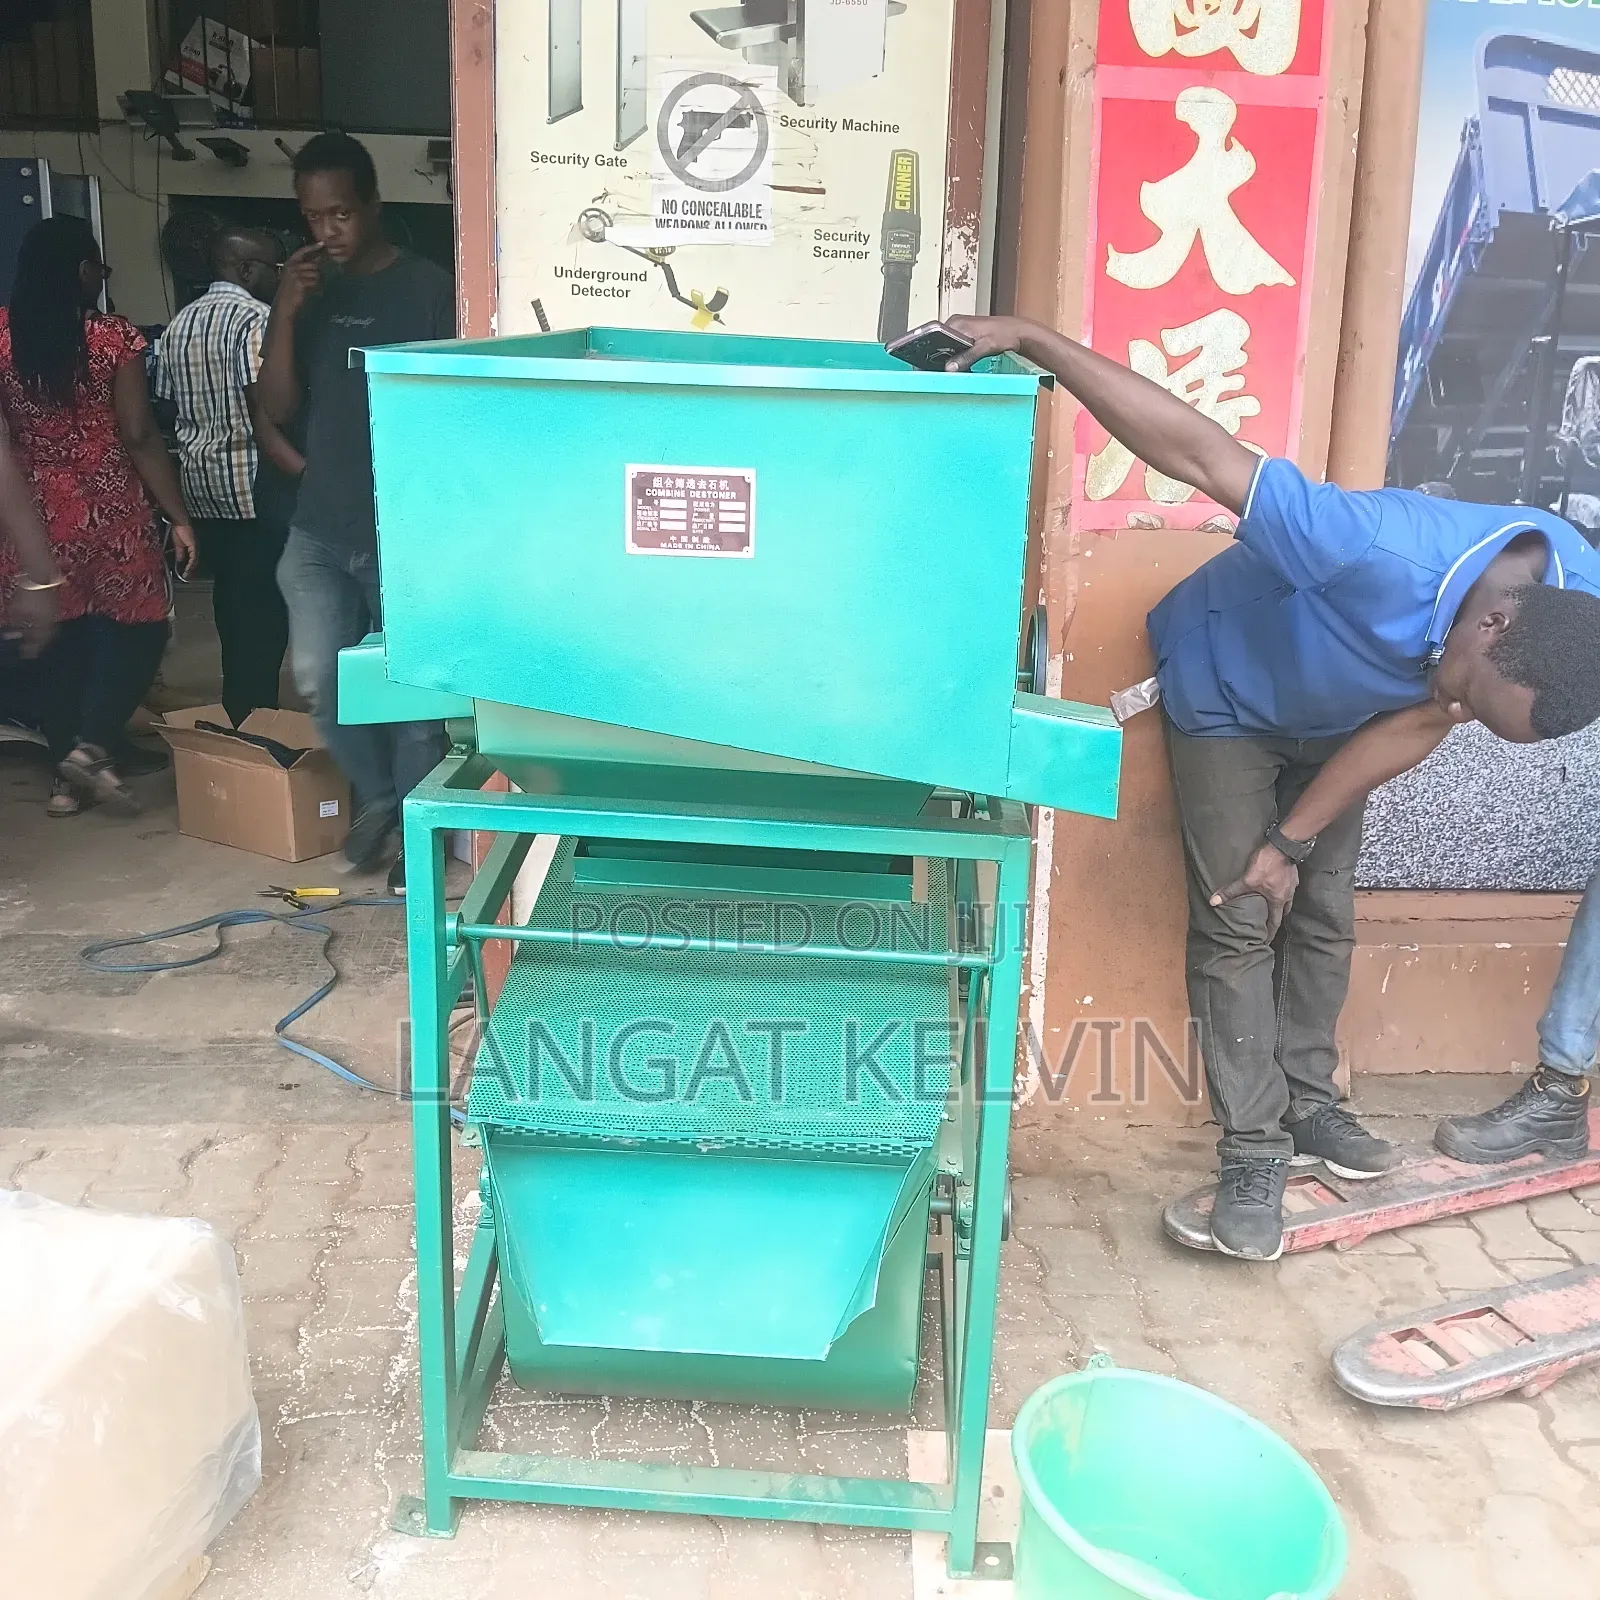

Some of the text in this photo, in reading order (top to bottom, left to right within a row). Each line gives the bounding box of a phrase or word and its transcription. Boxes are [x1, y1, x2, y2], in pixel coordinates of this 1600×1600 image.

[780, 114, 900, 134] Security Machine
[530, 150, 628, 169] Security Gate
[894, 156, 913, 213] CANNER
[661, 198, 763, 219] NO CONCEALABLE
[813, 228, 871, 246] Security
[813, 245, 871, 260] Scanner
[554, 265, 648, 283] Underground
[571, 283, 632, 299] Detector
[645, 488, 686, 498] COMBINE
[660, 542, 683, 550] MADE
[695, 543, 721, 551] CHINA
